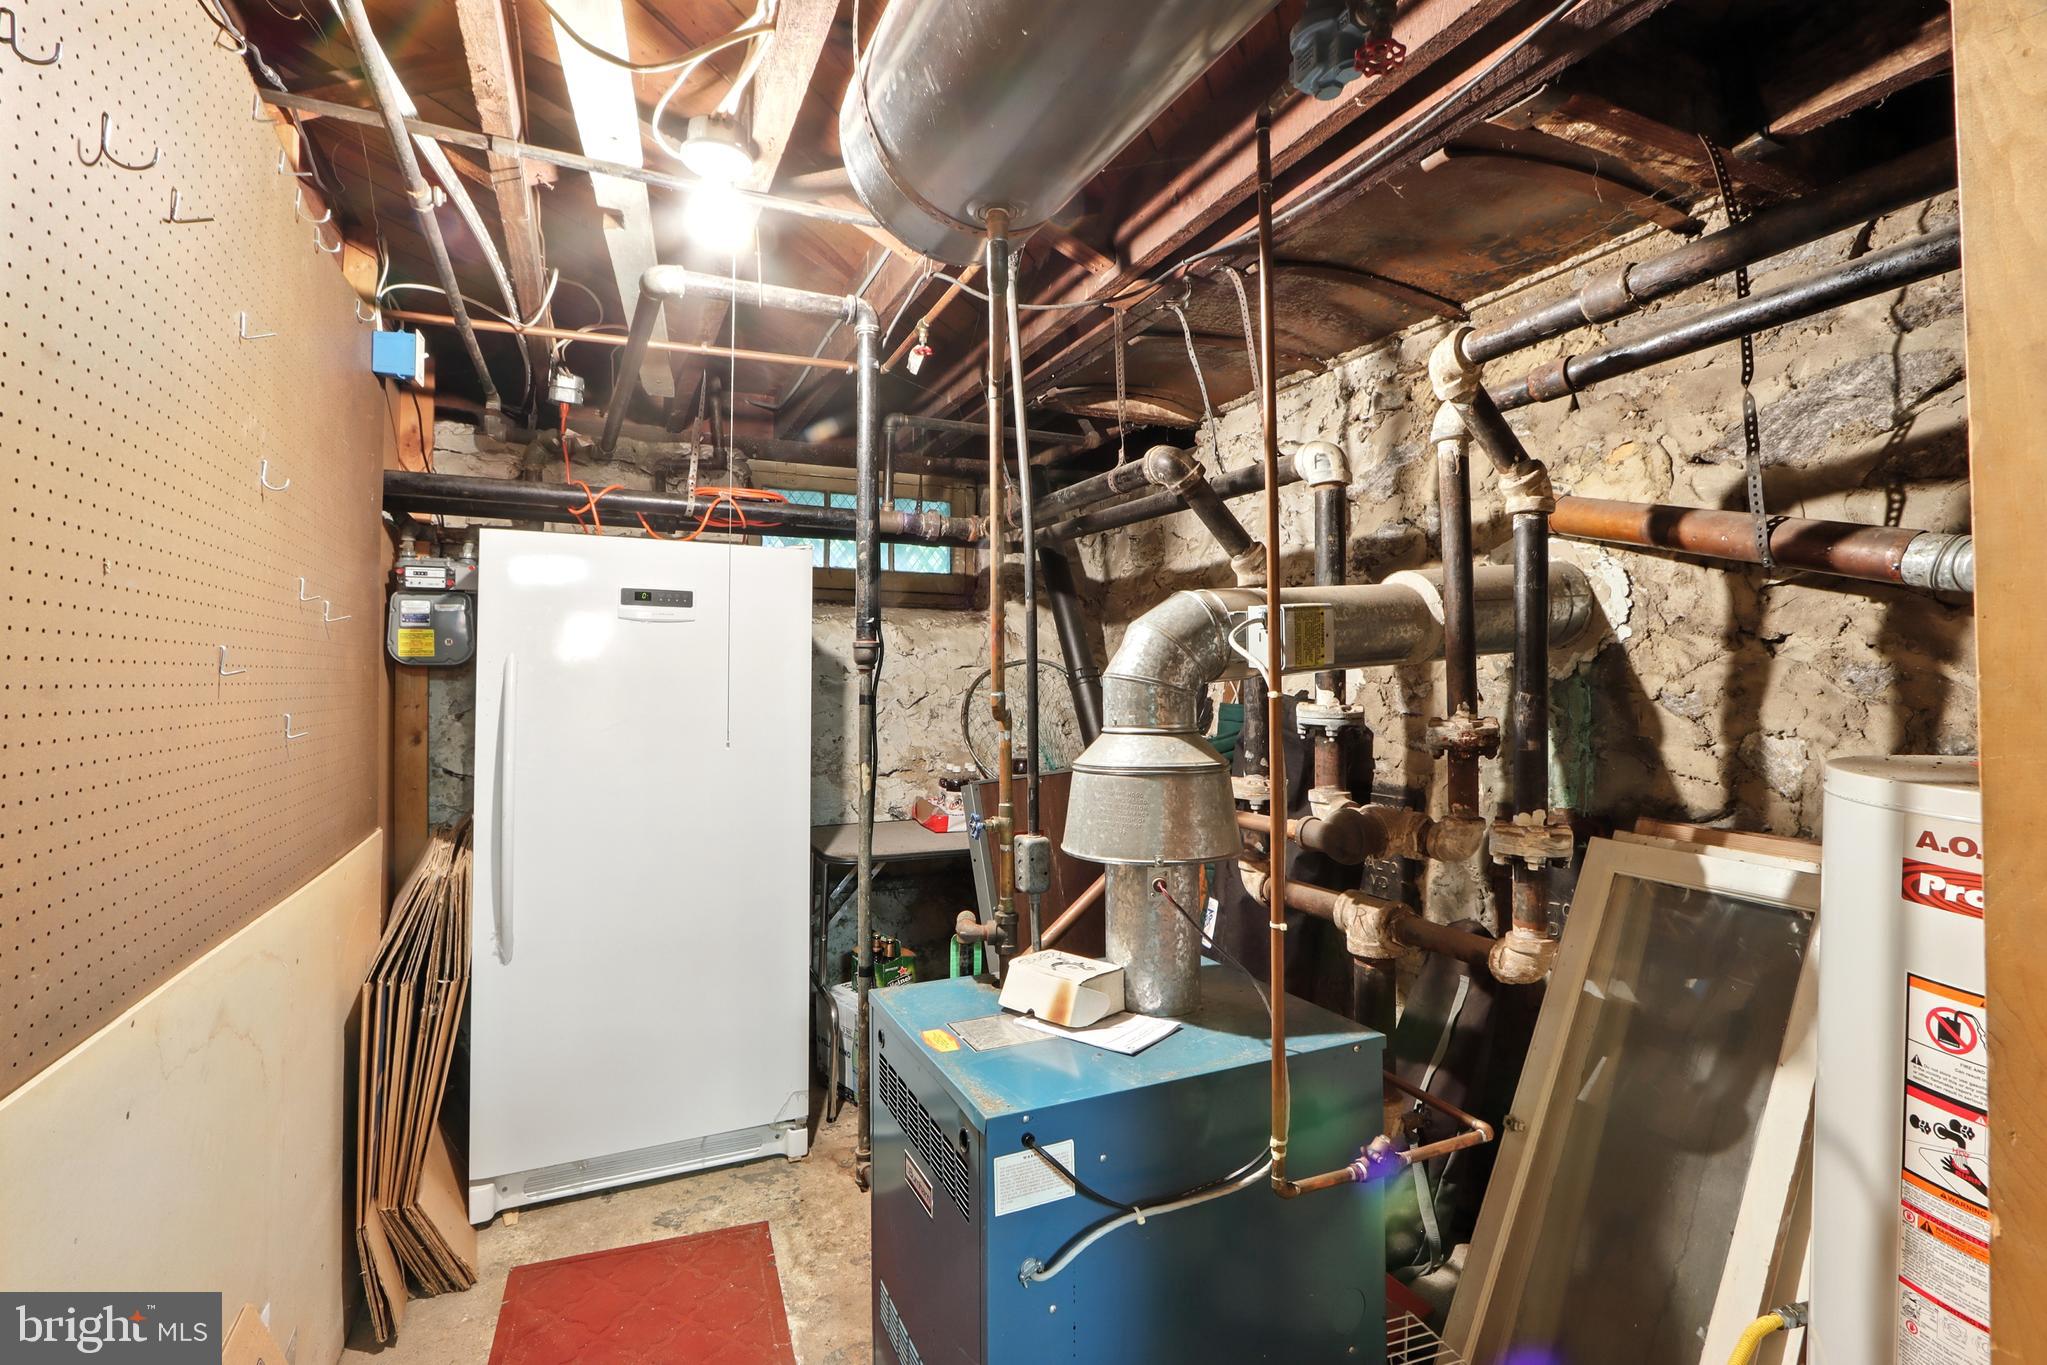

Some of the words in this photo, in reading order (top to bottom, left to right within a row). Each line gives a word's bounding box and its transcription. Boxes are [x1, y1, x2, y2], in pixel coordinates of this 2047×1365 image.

[1915, 830, 1983, 860] A.O.
[1353, 907, 1369, 937] R
[1947, 1194, 1988, 1218] WARNING
